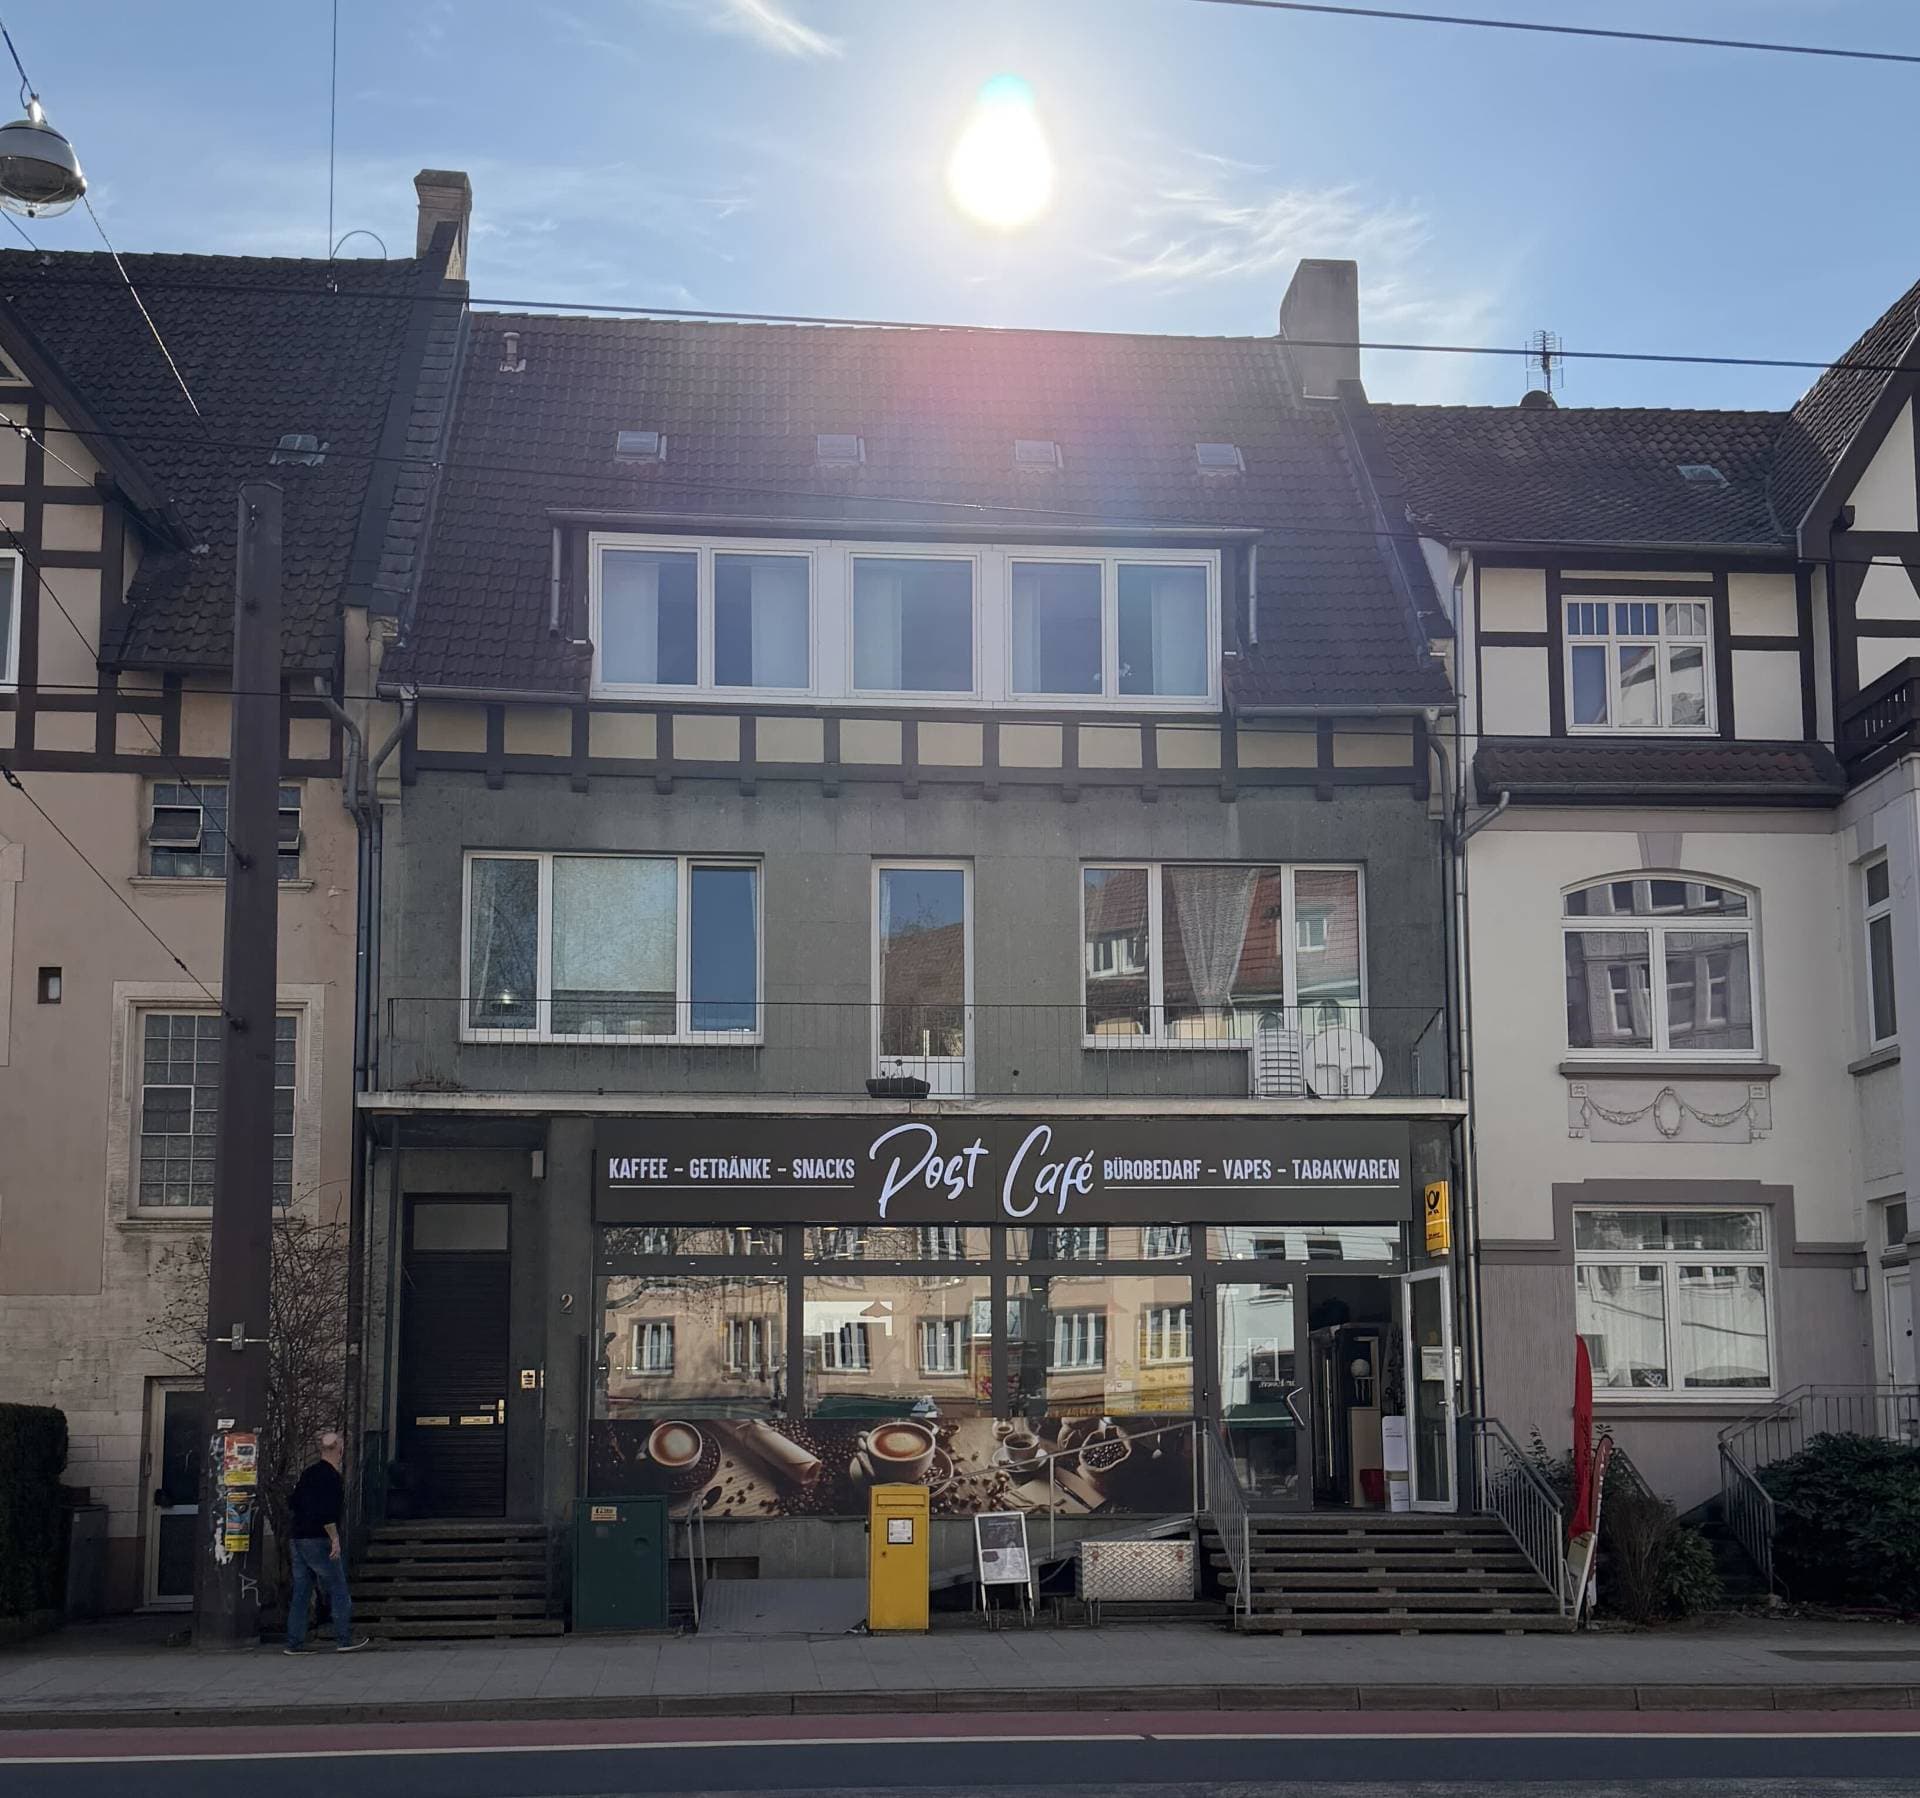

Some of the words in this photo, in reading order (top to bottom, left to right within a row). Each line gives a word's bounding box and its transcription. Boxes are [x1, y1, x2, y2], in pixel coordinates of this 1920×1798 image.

[608, 1158, 669, 1179] KAFFEE
[688, 1155, 772, 1179] GETRÄNKE
[792, 1158, 856, 1179] SNACKS
[868, 1123, 990, 1219] Post
[1002, 1124, 1095, 1218] Café
[1103, 1157, 1202, 1180] BÜROBEDARF
[1222, 1159, 1272, 1180] VAPES
[1292, 1159, 1400, 1180] TABAKWAREN
[559, 1293, 574, 1314] 2
